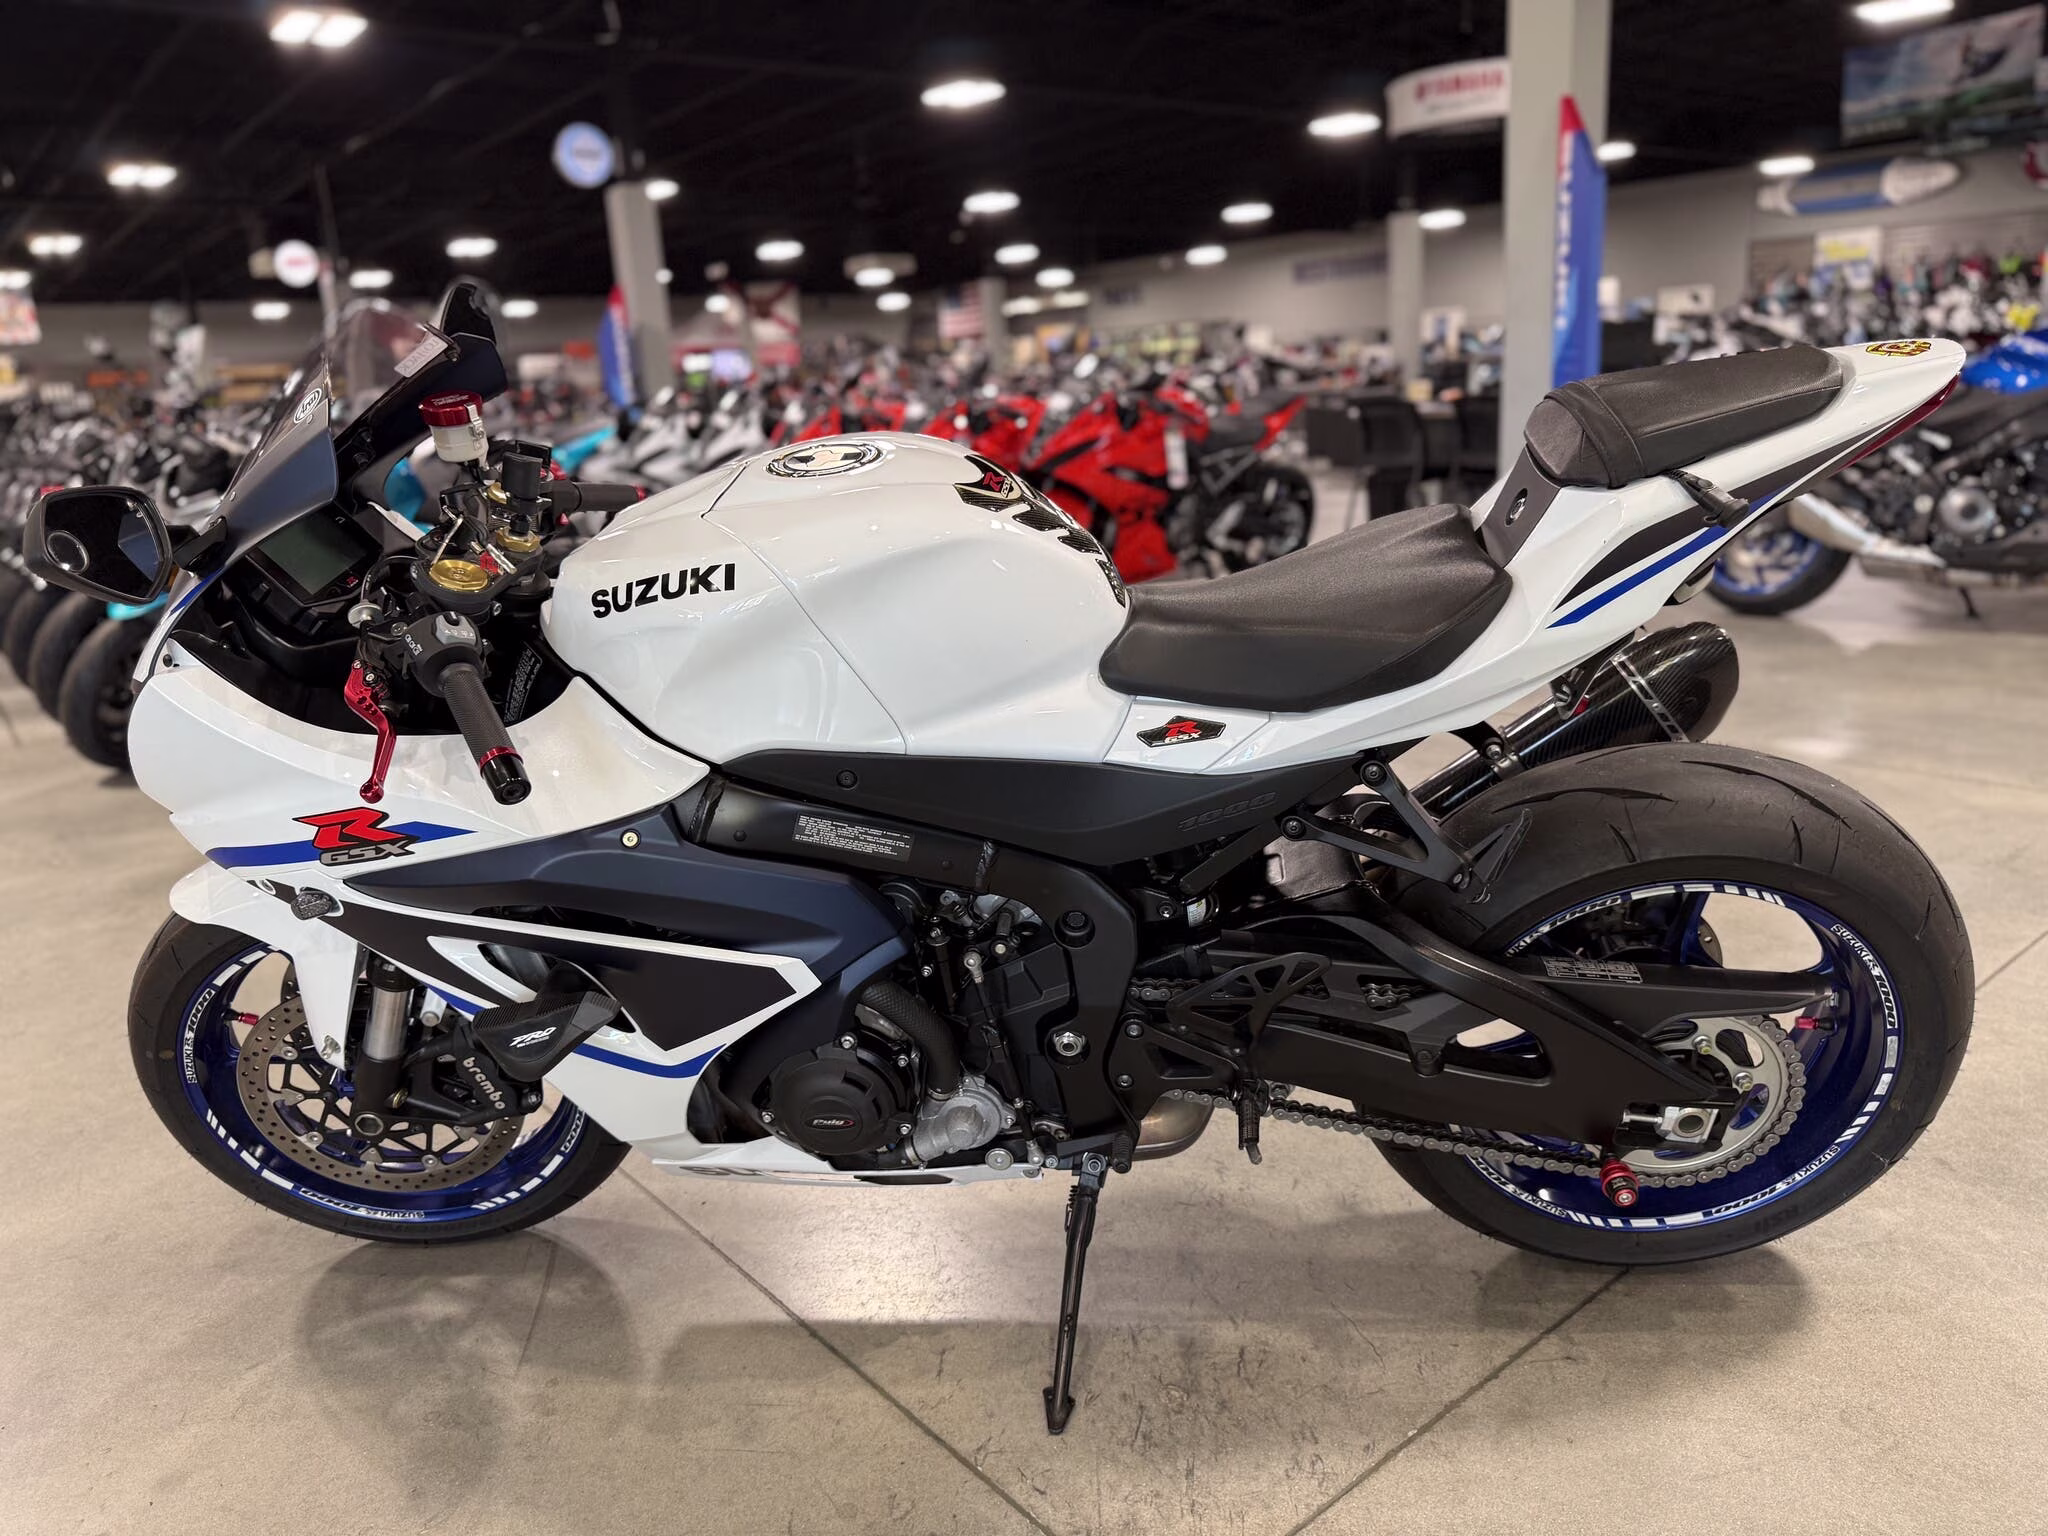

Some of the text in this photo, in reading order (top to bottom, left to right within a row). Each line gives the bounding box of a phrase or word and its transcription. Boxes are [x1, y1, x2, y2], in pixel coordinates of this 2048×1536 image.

[591, 563, 736, 619] SUZUKI
[292, 806, 420, 850] R
[320, 840, 415, 866] GSX
[1832, 924, 1869, 962] SUZUKI
[1873, 971, 1898, 1028] 1000
[188, 988, 214, 1034] 1000
[184, 1048, 196, 1083] SUZUKI
[463, 1056, 506, 1110] brembo
[1712, 1144, 1840, 1215] SUZUKI 1000
